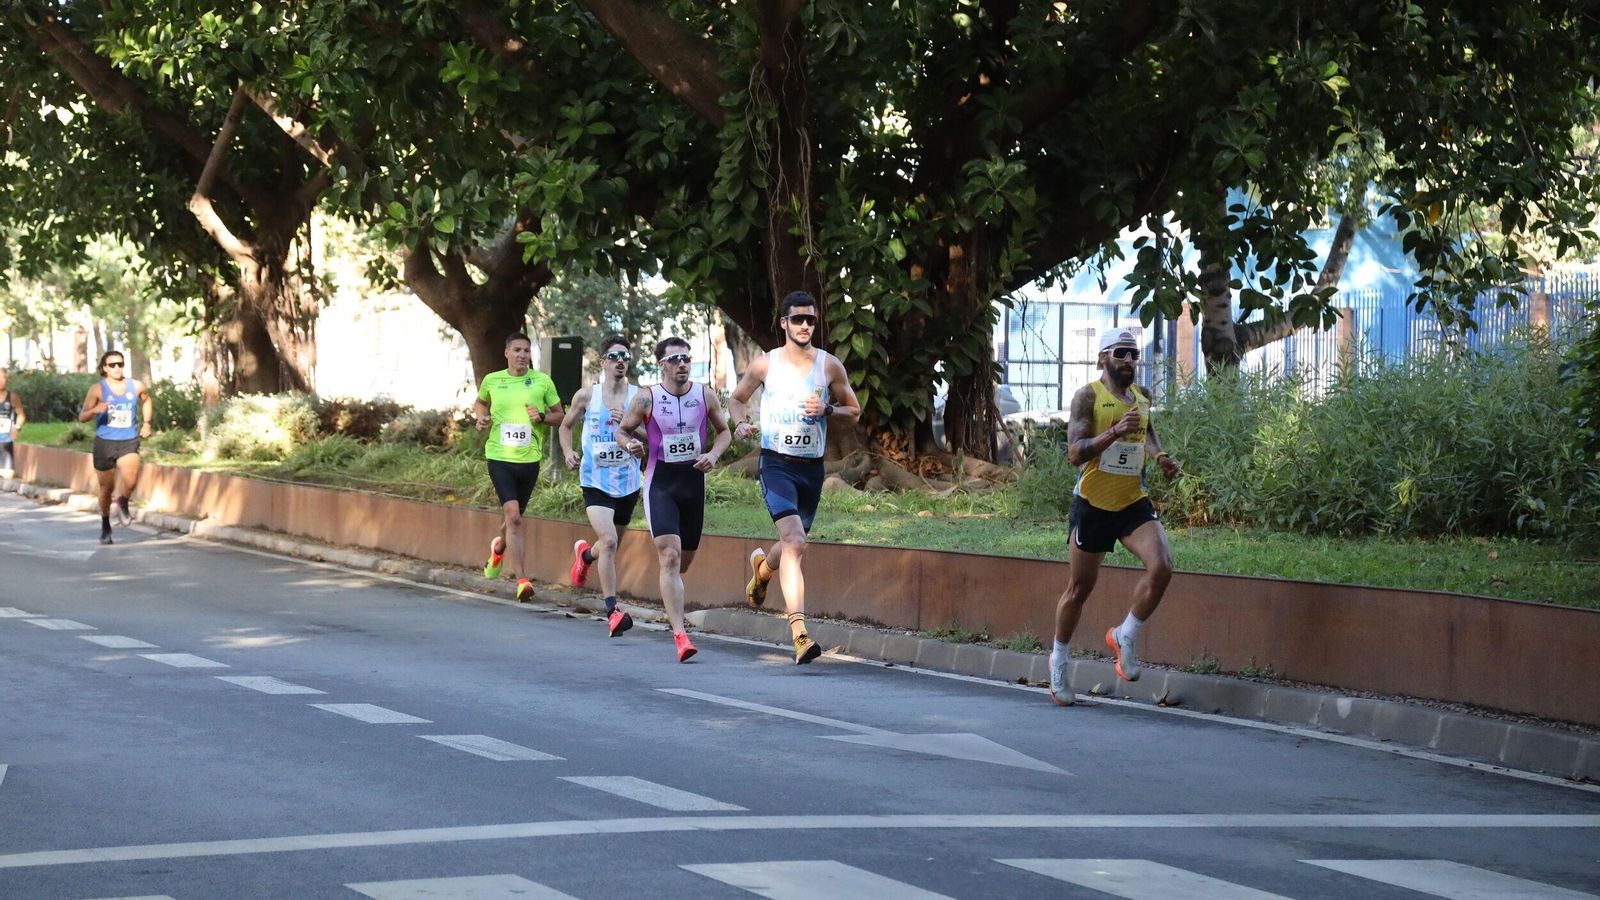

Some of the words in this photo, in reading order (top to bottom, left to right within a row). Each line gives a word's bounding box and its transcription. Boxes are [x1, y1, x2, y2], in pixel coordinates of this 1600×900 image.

[505, 431, 526, 439] 148
[784, 434, 811, 445] 870
[669, 442, 695, 453] 834
[599, 450, 624, 460] 312
[1118, 453, 1128, 465] 5
